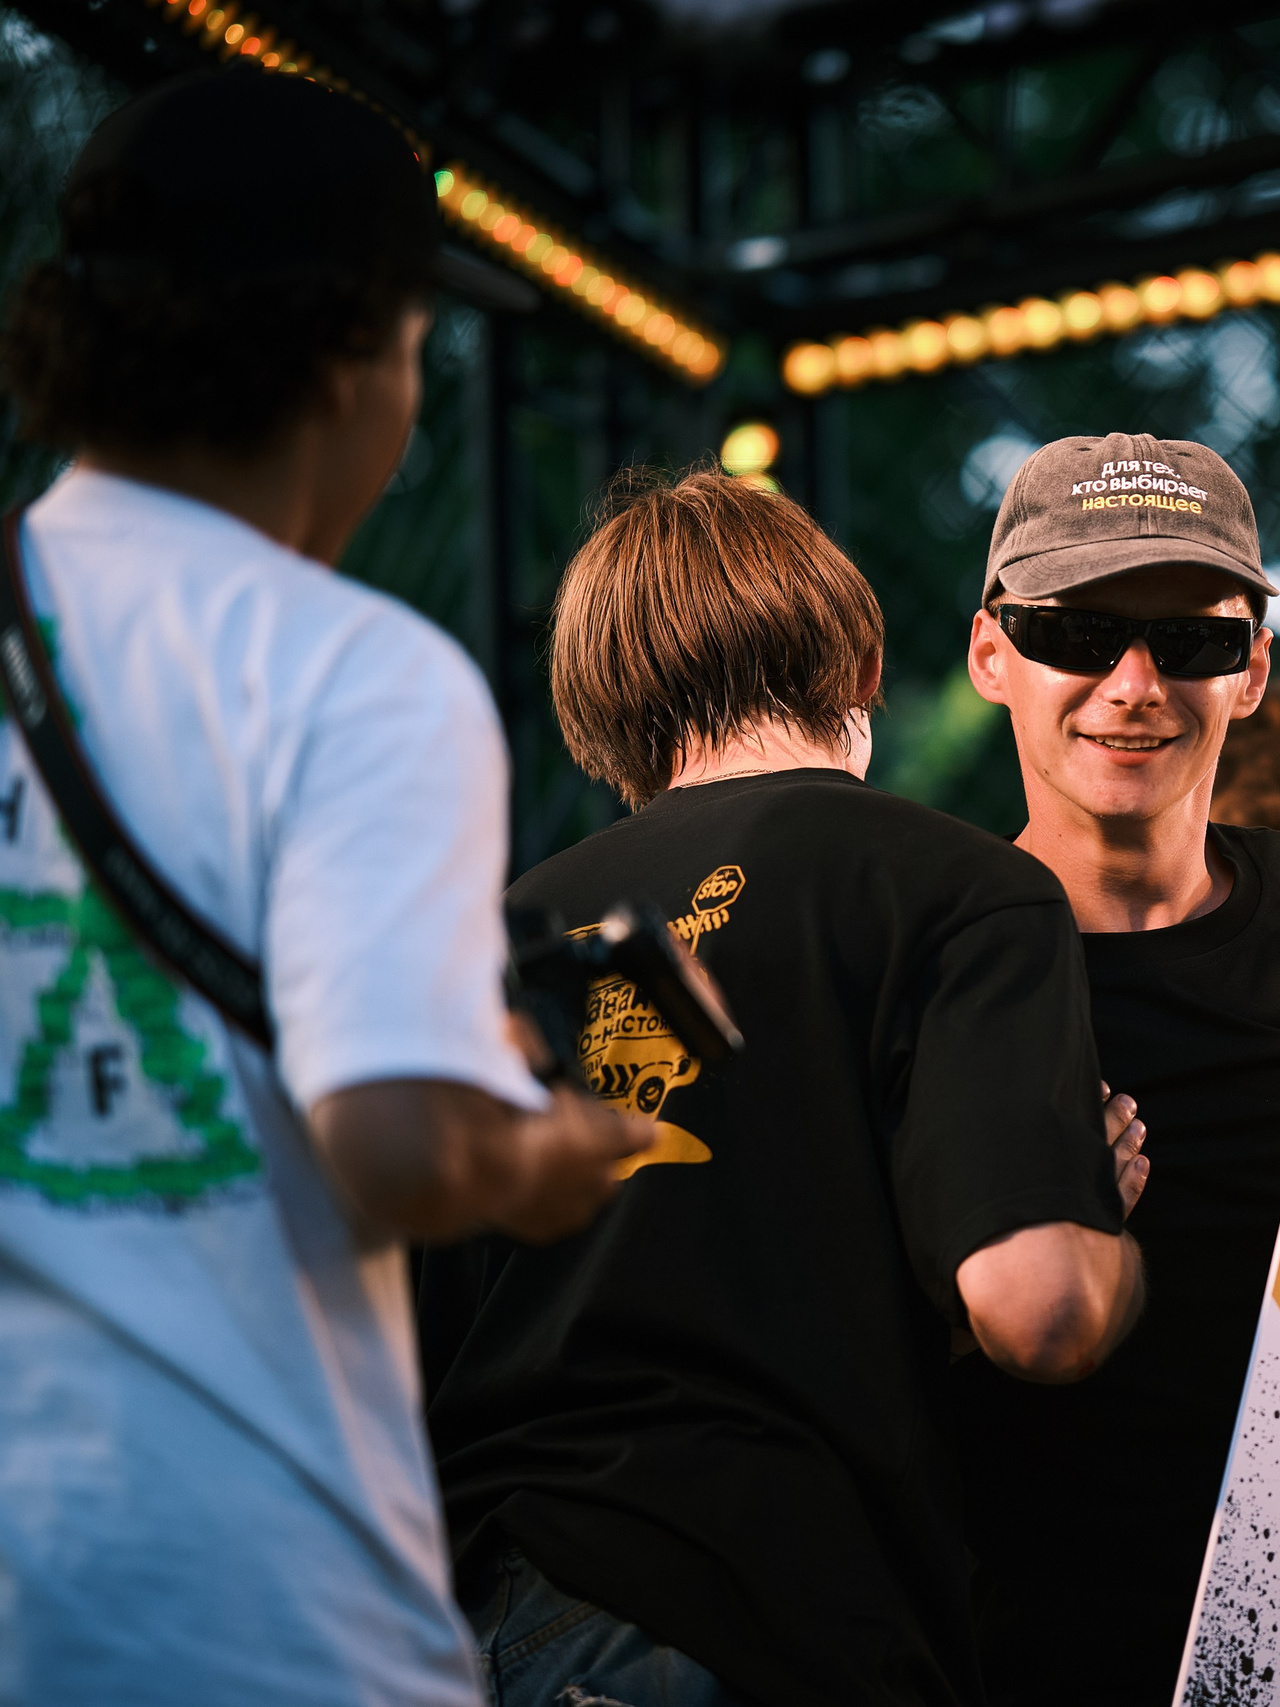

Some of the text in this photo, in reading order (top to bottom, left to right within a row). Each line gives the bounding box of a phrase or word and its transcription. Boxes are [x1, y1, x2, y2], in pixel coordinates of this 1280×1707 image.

[1071, 474, 1208, 500] кто выбирает
[1082, 494, 1202, 514] настоящее
[698, 880, 738, 900] STOP
